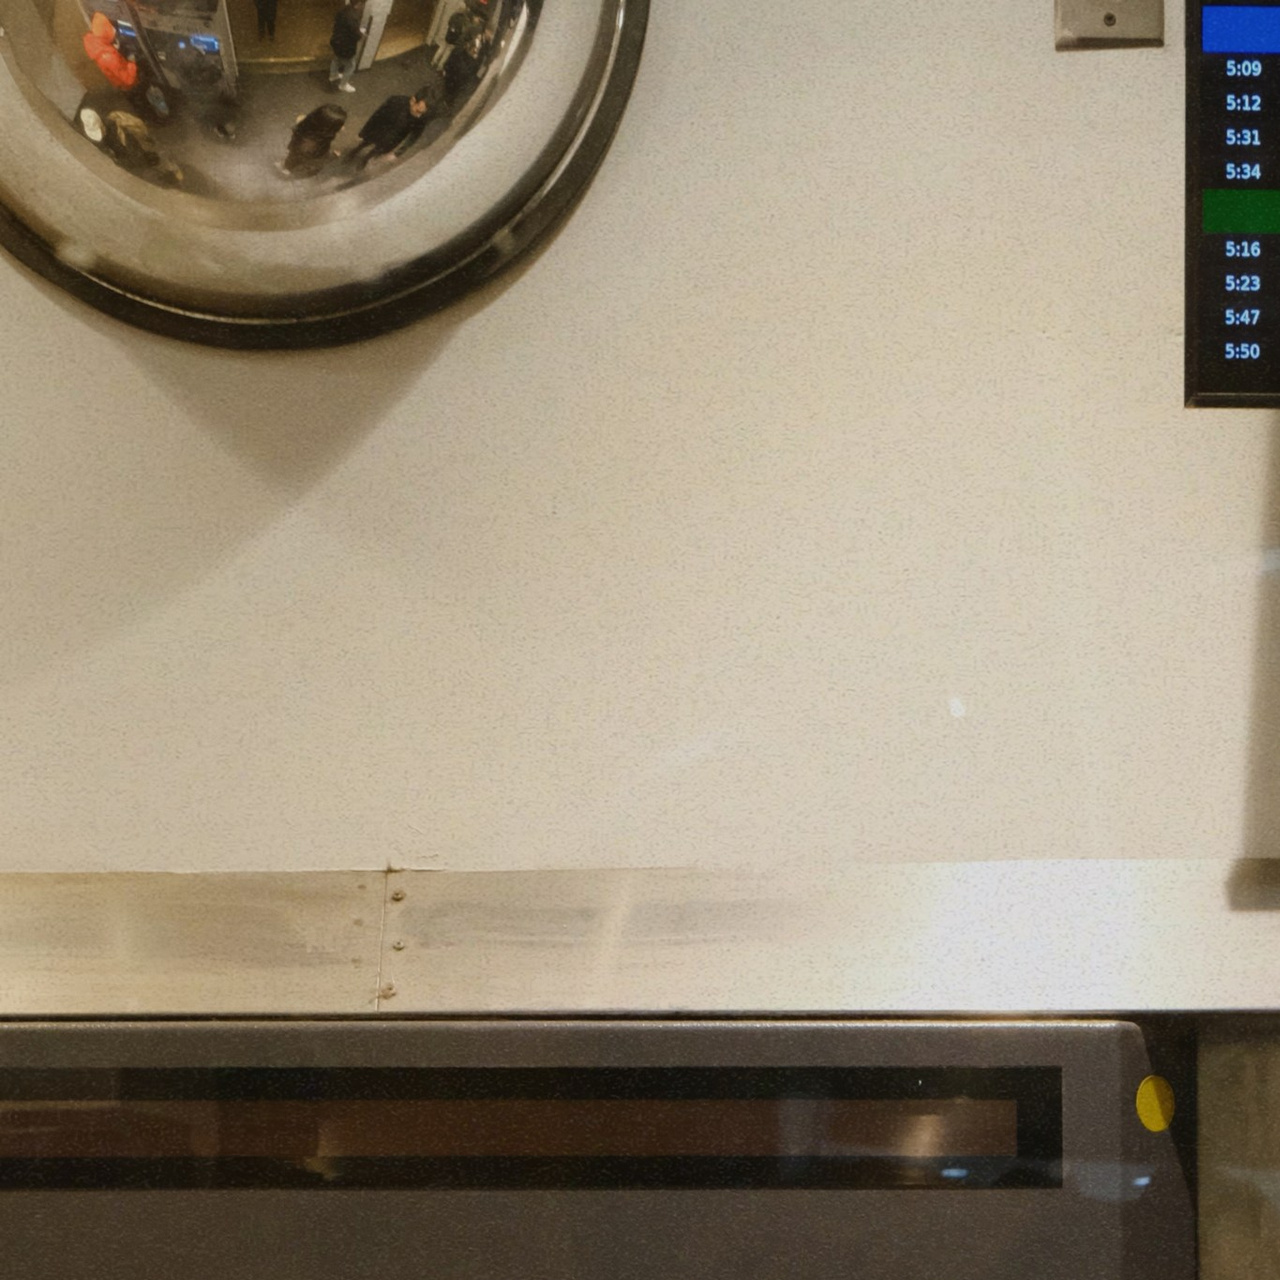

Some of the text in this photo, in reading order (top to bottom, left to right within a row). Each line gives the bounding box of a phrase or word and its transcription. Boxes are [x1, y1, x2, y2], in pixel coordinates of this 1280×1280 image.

[1227, 60, 1261, 76] 5:09
[1227, 95, 1261, 111] 5:12
[1226, 129, 1260, 145] 5:31
[1226, 163, 1261, 179] 5:34
[1226, 241, 1260, 257] 5:16
[1226, 275, 1260, 291] 5:23
[1226, 309, 1260, 325] 5:47
[1226, 343, 1260, 359] 5:50
